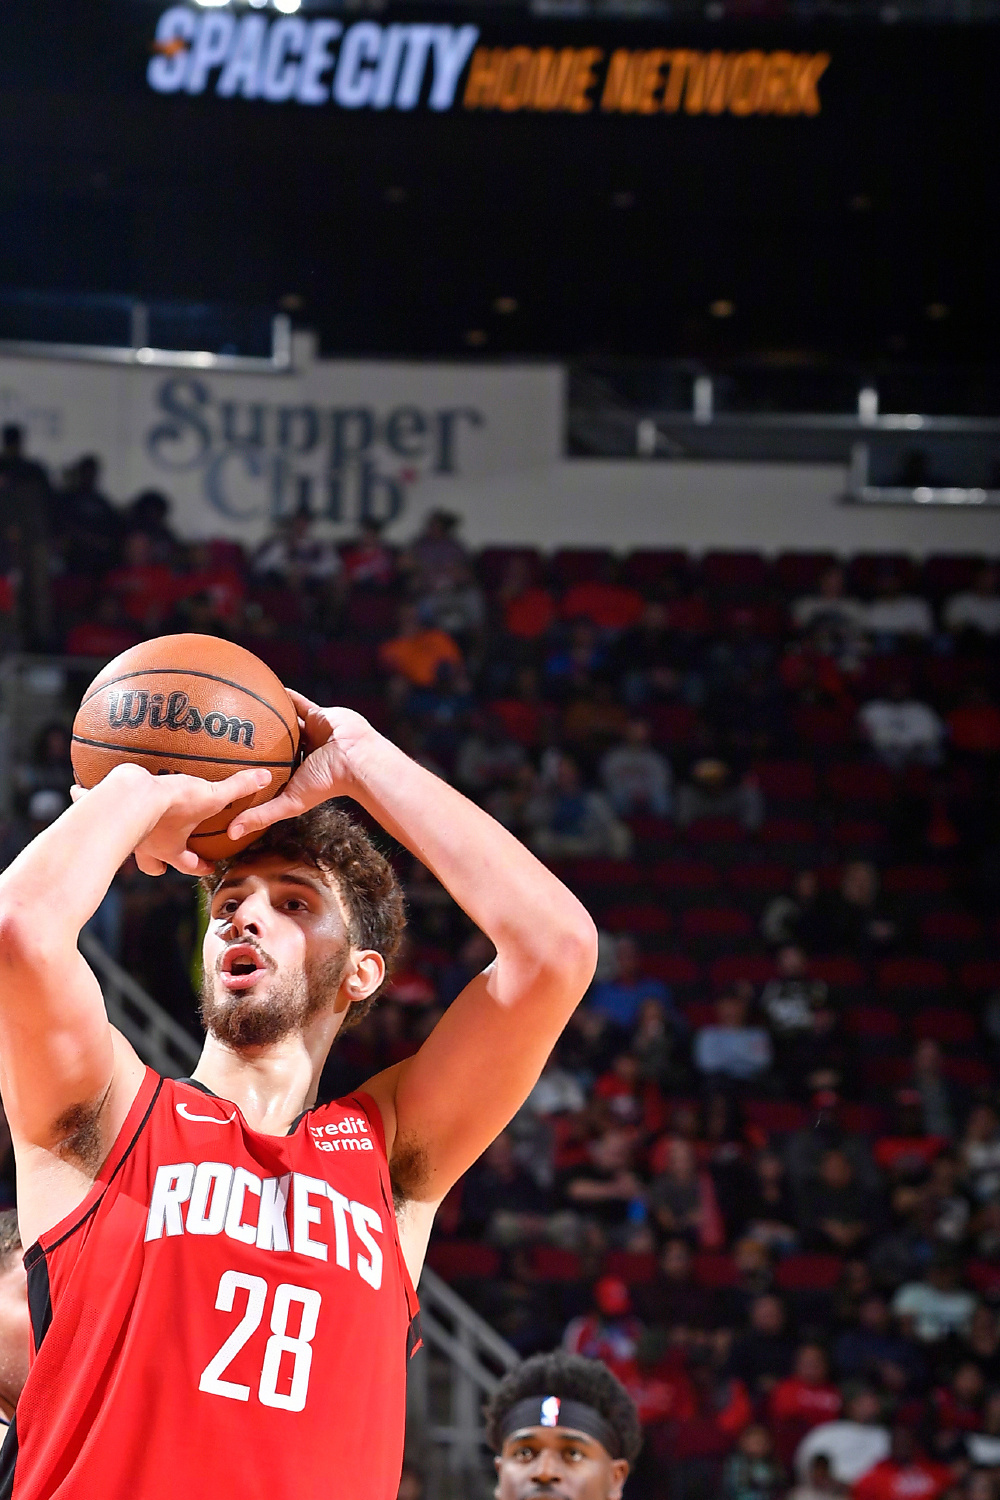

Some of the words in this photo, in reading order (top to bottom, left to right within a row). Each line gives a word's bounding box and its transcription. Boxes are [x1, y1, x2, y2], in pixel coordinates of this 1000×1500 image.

[147, 6, 342, 105] SPACE
[333, 20, 480, 111] CITY
[462, 45, 602, 113] HOME
[601, 48, 831, 116] NETWORK
[144, 374, 486, 476] Supper
[205, 445, 406, 526] Club
[108, 689, 255, 750] Wilson
[144, 1161, 383, 1291] ROCKETS
[198, 1270, 322, 1413] 28
